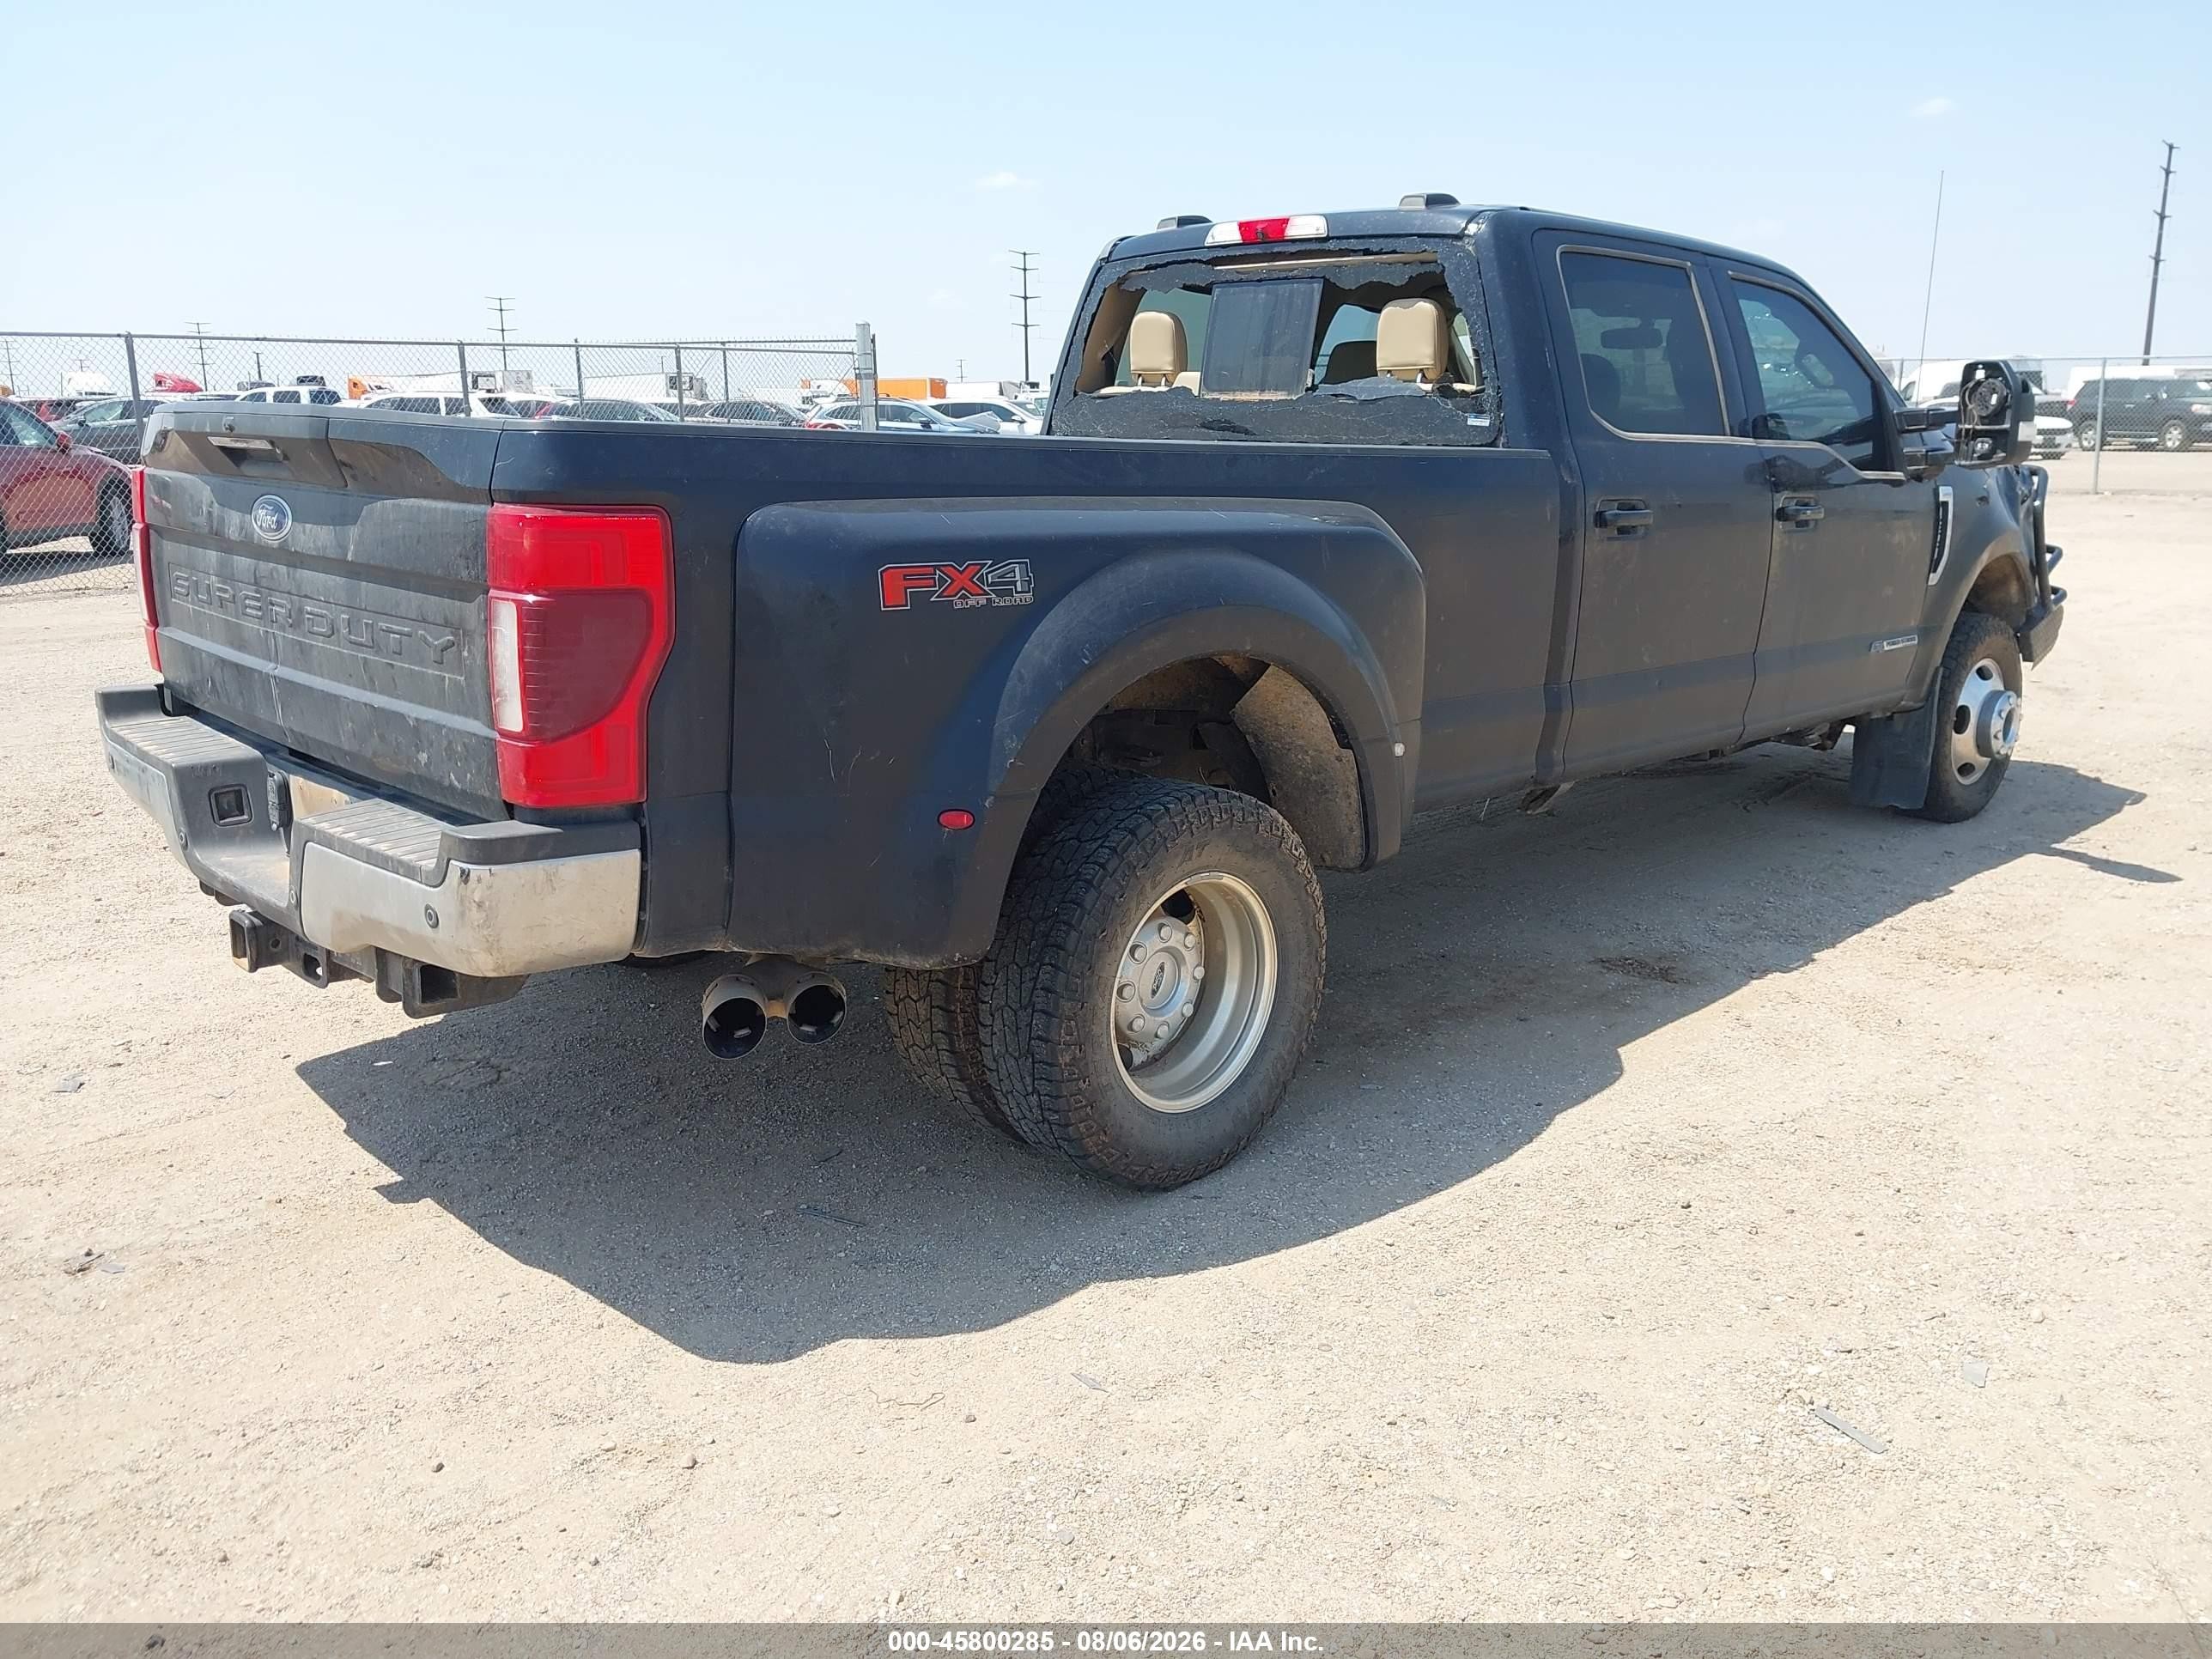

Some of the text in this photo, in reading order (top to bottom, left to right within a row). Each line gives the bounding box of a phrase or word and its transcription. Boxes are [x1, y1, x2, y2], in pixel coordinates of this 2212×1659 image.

[256, 503, 279, 530] Ford
[878, 559, 1034, 611] FX4
[953, 595, 1034, 609] OFF ROAD
[172, 571, 456, 665] SUPER DUTY
